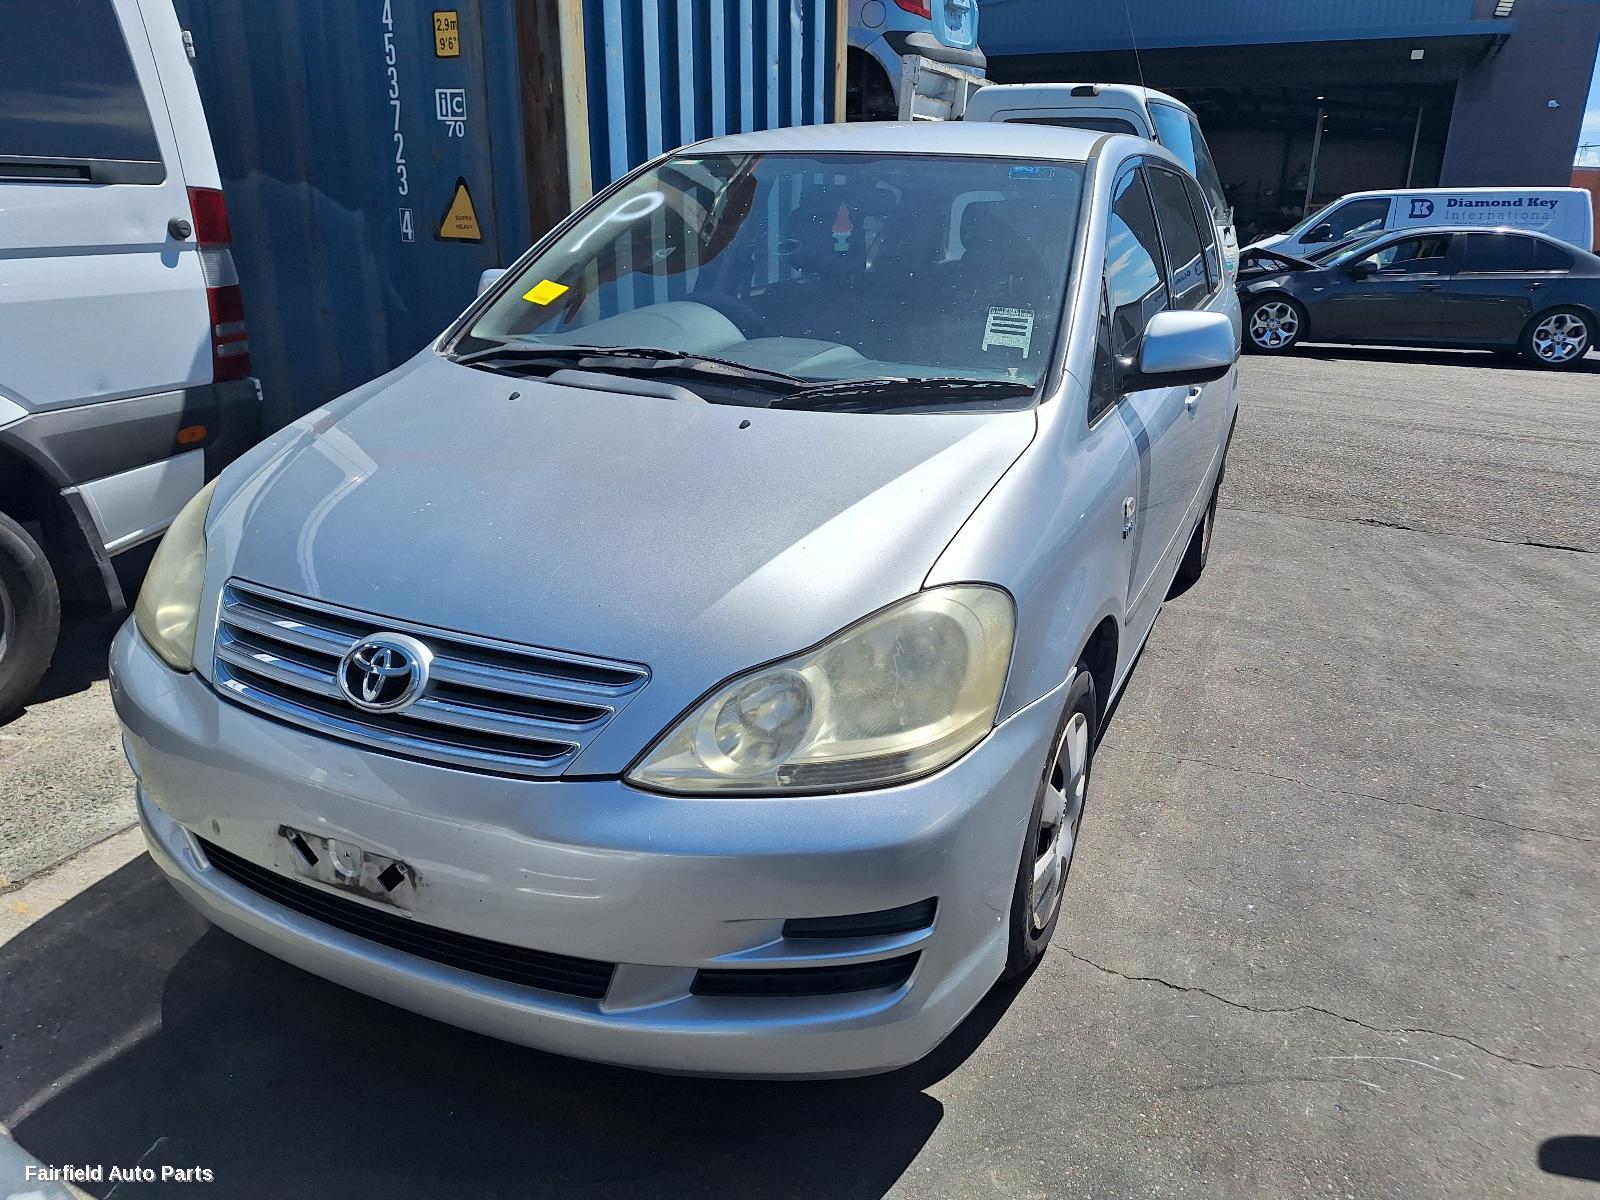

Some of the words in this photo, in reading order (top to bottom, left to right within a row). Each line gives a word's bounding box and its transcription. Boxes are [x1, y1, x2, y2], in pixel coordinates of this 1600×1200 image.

[445, 121, 465, 138] 70
[1446, 197, 1523, 208] Diamond
[1527, 197, 1559, 209] Key
[1444, 208, 1557, 220] International
[403, 210, 413, 240] 4
